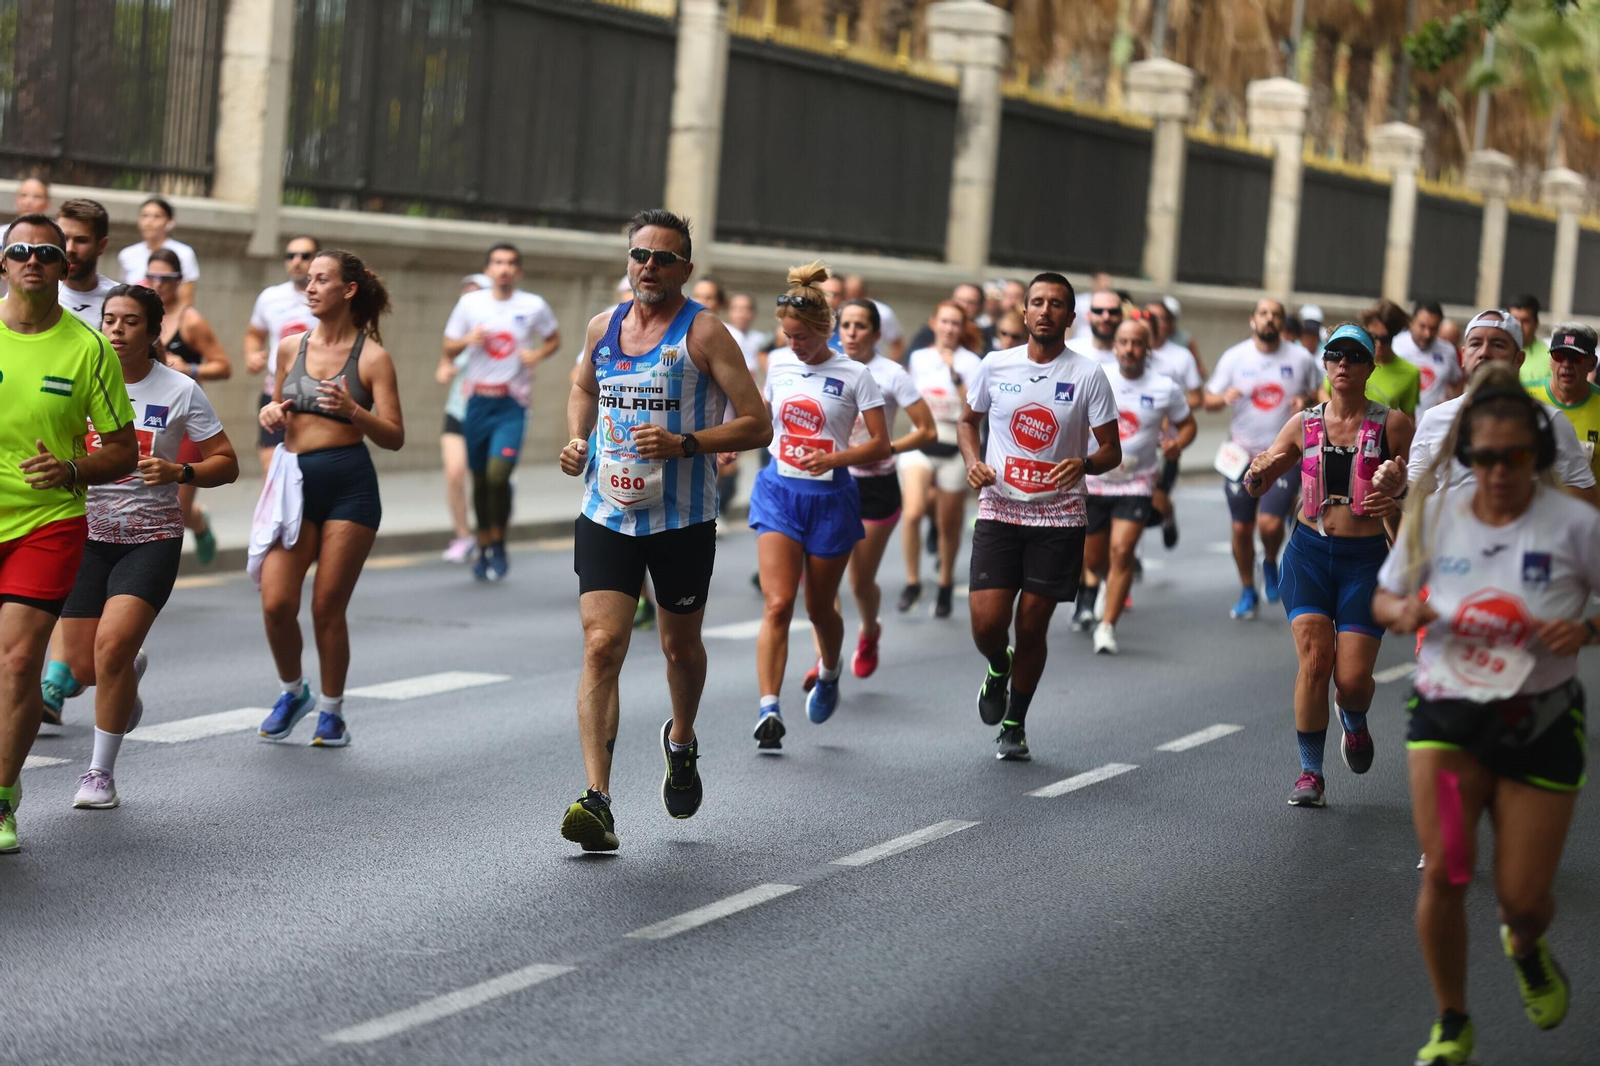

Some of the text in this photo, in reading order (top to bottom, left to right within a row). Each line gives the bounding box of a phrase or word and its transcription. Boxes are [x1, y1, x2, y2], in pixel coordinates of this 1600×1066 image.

[602, 385, 663, 393] ATLETISMO
[1054, 391, 1071, 400] AXA
[144, 415, 163, 427] AXA
[784, 413, 817, 431] FRENO
[786, 404, 820, 423] PONLE
[1016, 422, 1050, 442] FRENO
[1019, 413, 1053, 434] PONLE
[611, 474, 645, 490] 680
[1010, 467, 1052, 484] 2122
